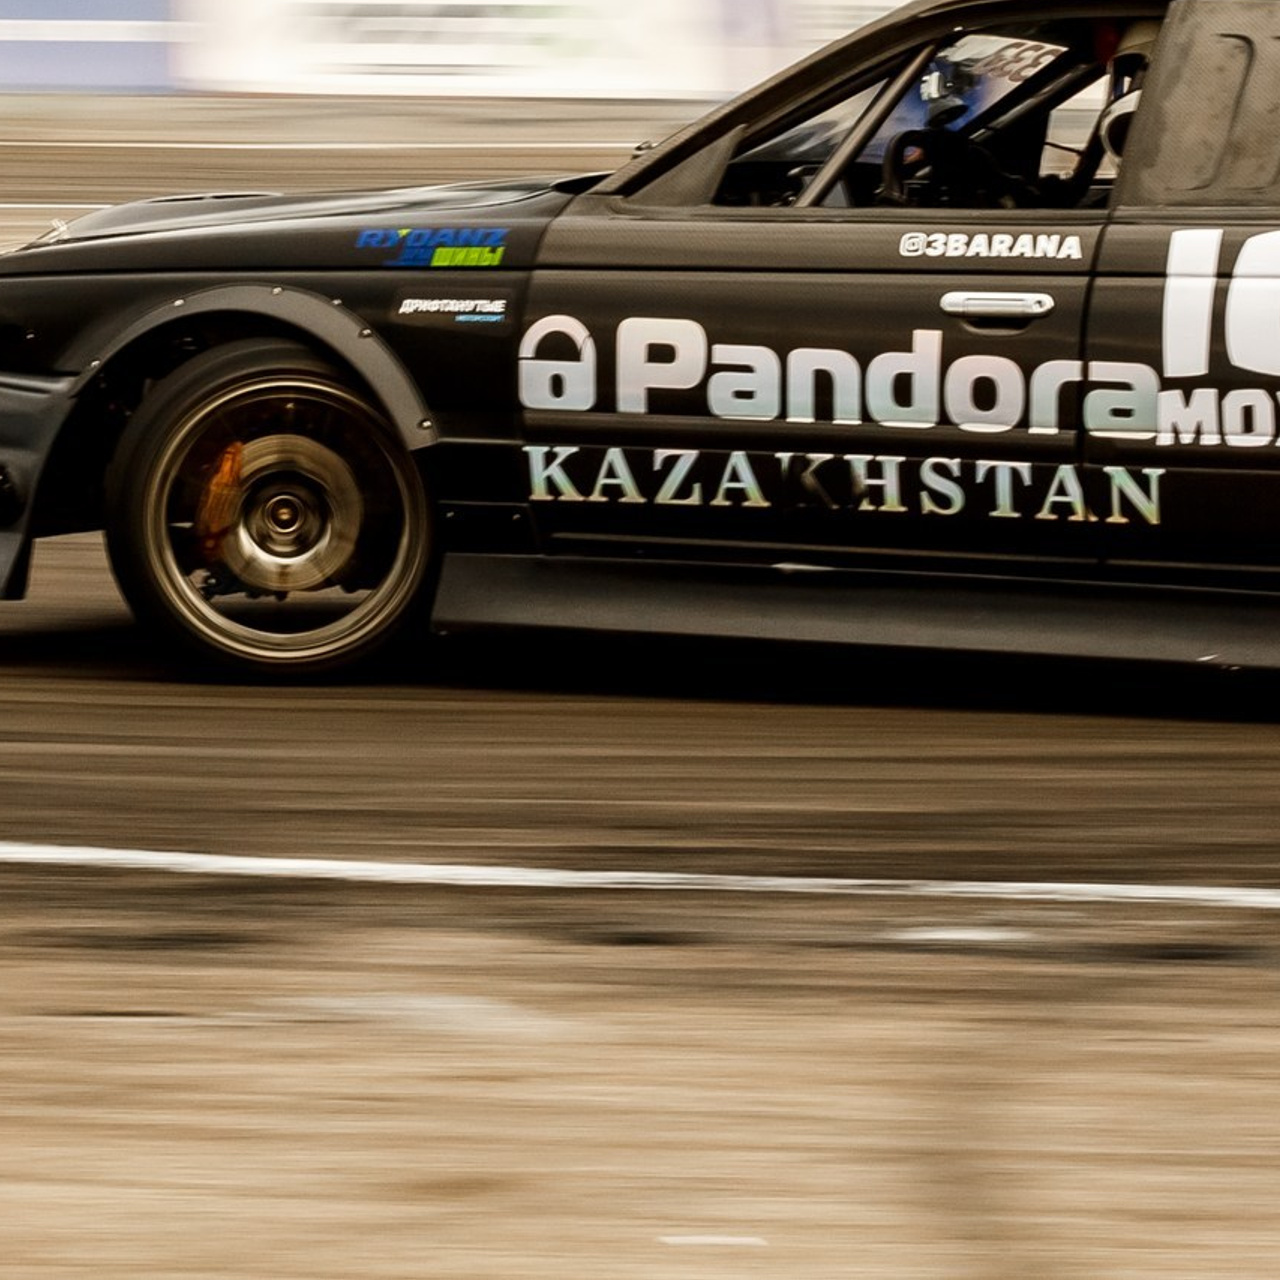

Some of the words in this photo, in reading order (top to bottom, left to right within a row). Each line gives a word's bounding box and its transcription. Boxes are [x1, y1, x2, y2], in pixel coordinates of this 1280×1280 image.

[356, 228, 511, 248] RYDANZ
[899, 232, 1083, 260] @3BARANA
[615, 316, 1161, 440] Pandora
